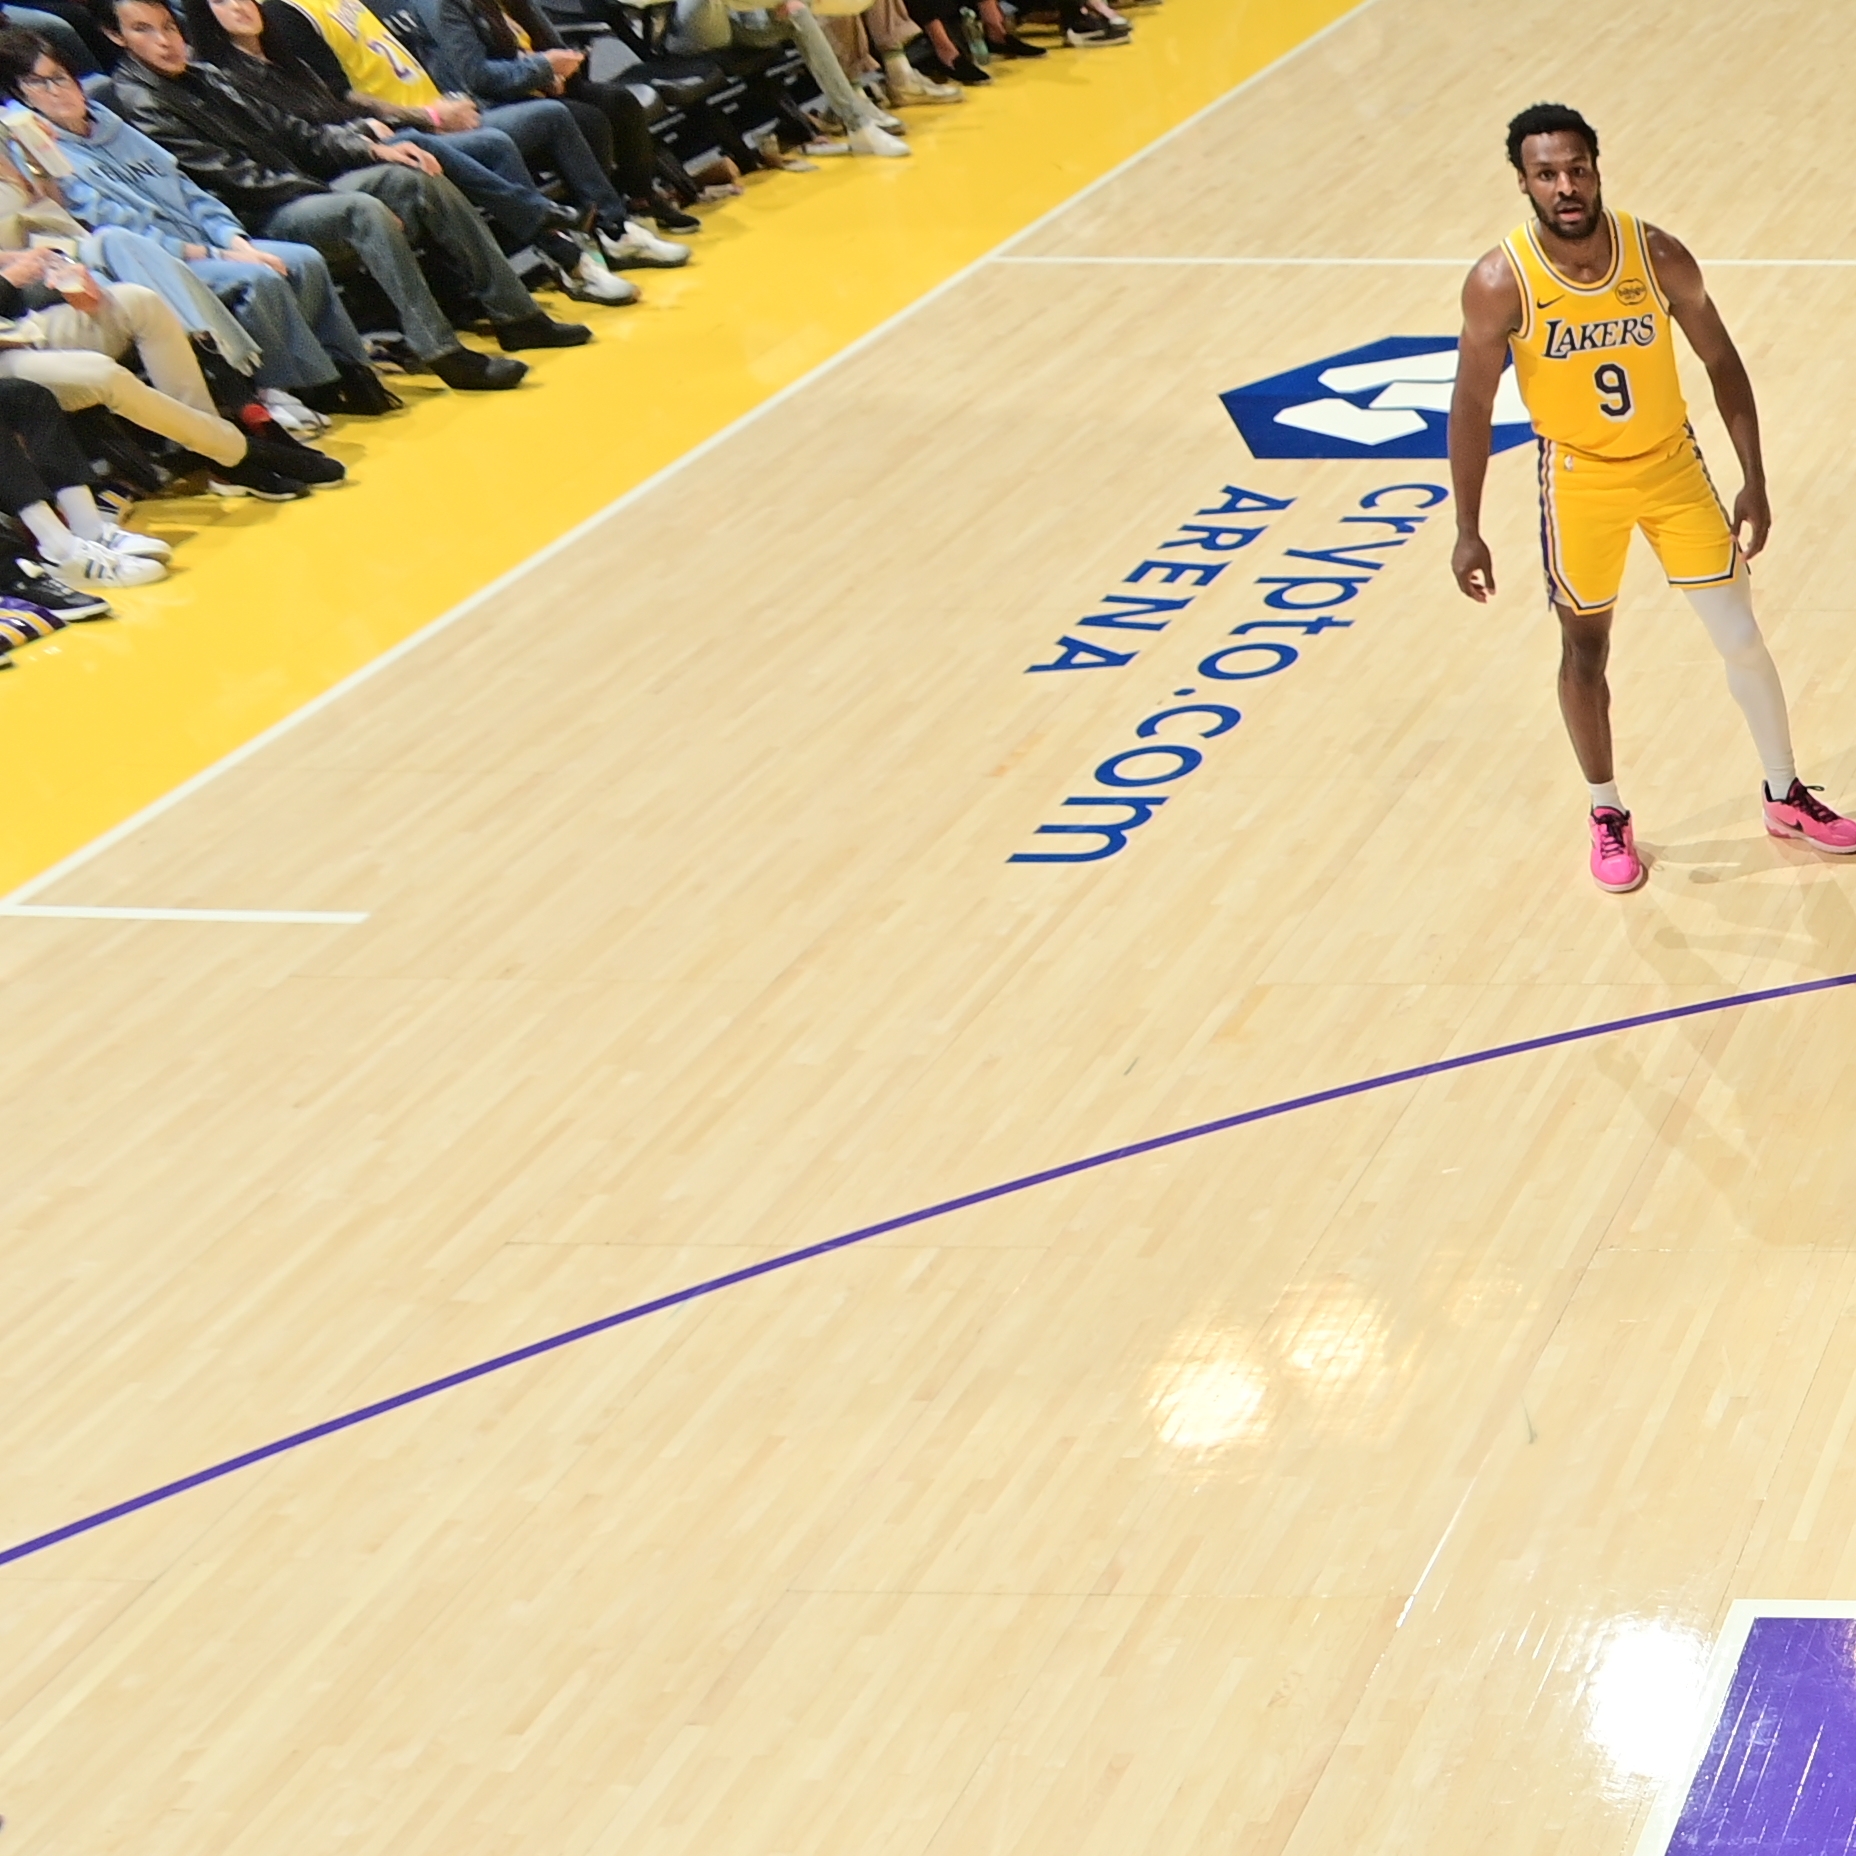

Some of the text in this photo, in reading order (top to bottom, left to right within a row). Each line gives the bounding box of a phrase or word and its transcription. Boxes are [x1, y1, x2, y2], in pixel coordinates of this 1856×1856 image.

[1541, 313, 1657, 360] LAKERS
[1593, 361, 1636, 422] 9
[1024, 485, 1297, 675] ARENA
[1006, 482, 1449, 864] crypto.com
